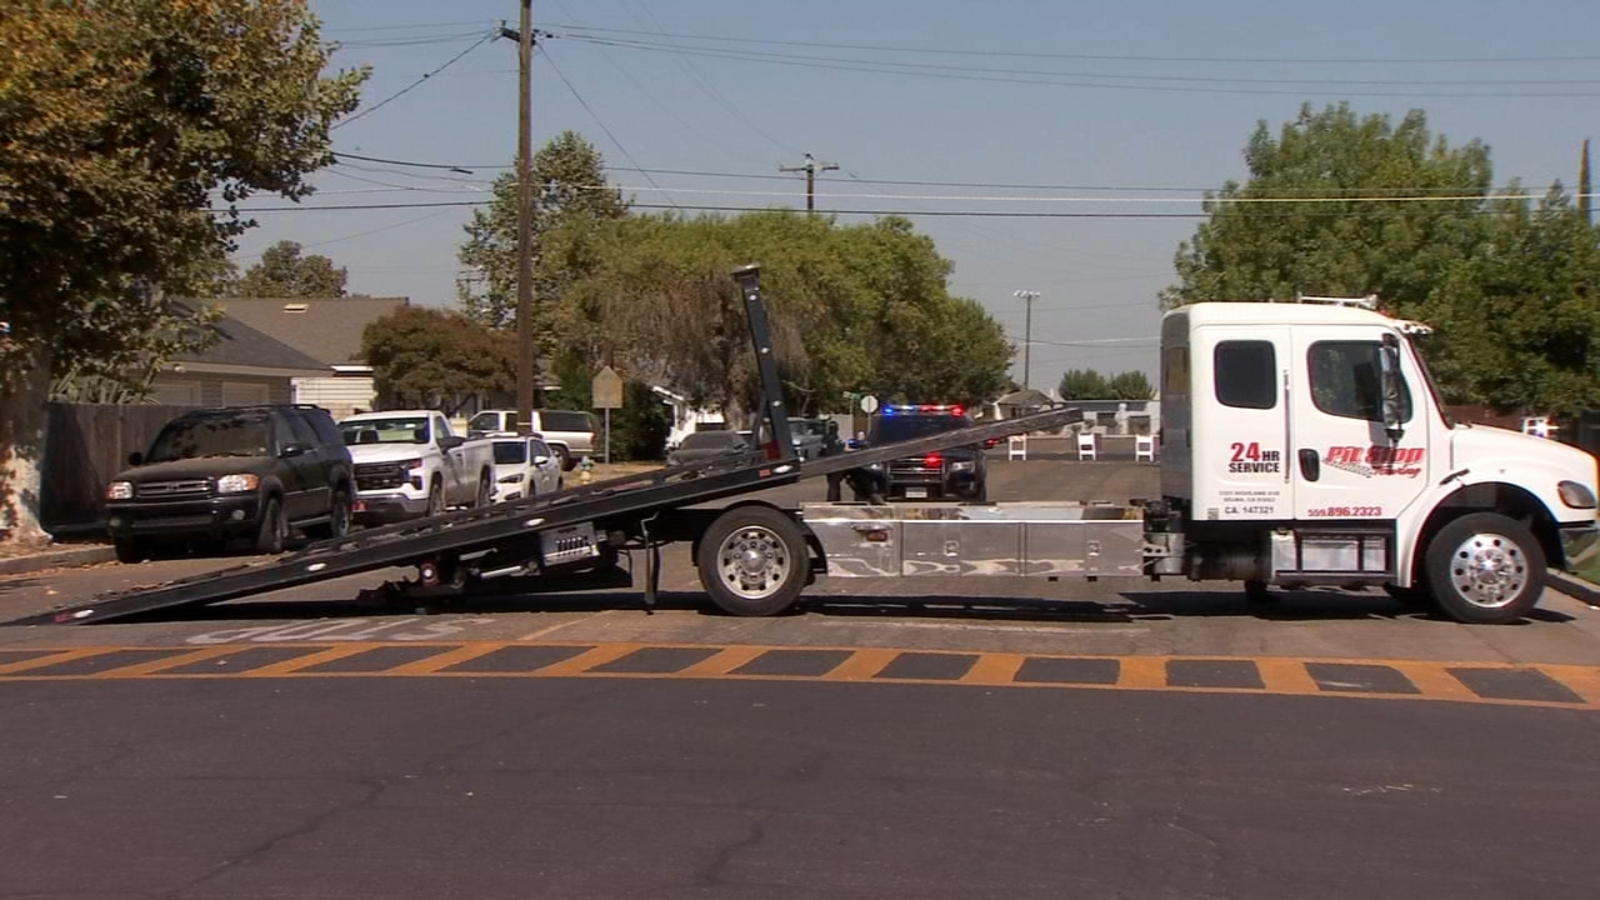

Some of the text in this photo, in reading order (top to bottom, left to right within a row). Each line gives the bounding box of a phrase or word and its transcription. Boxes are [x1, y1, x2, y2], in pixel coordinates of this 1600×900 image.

[1230, 442, 1280, 461] 24 HR
[1229, 462, 1280, 473] SERVICE
[1308, 507, 1382, 517] 559.896.2323
[186, 618, 495, 643] STOP
